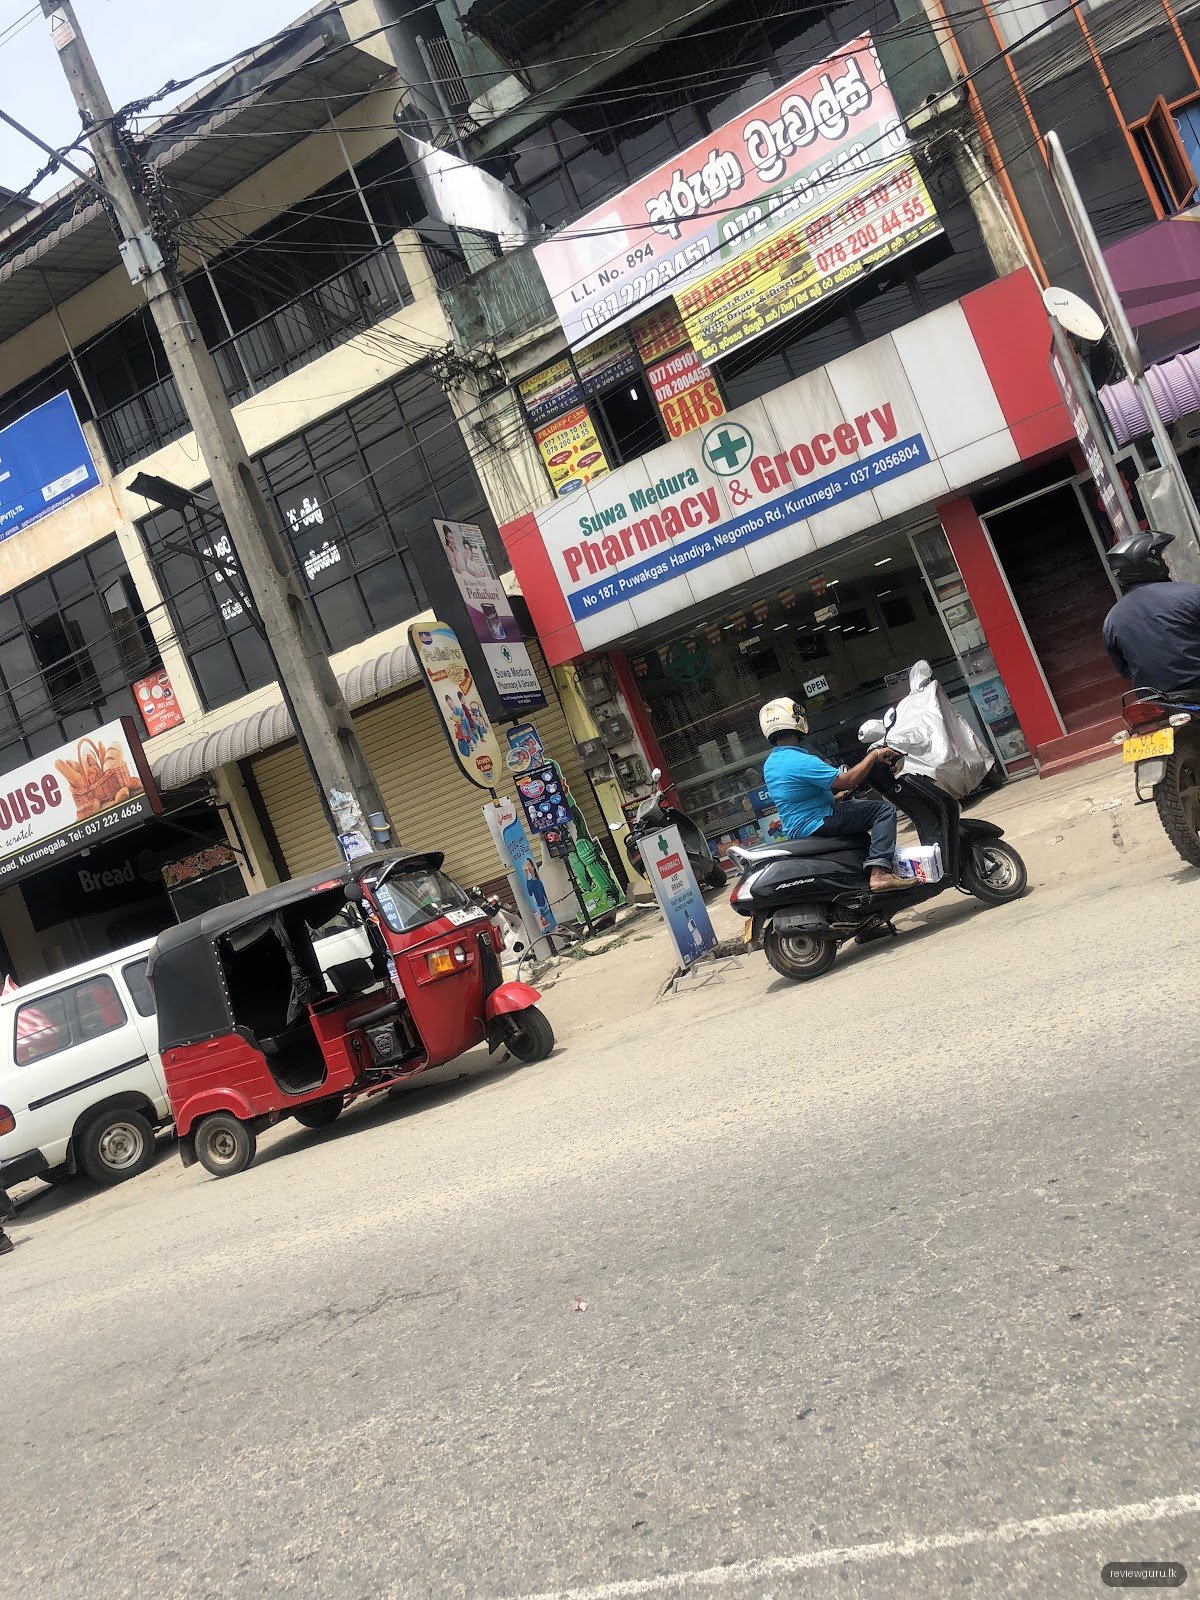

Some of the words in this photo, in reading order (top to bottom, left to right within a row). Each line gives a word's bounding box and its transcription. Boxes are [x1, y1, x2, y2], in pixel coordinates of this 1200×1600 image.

[816, 242, 847, 273] 078
[847, 223, 878, 255] 200
[881, 209, 902, 235] 44
[902, 196, 925, 223] 55
[571, 283, 596, 303] L.L.
[598, 267, 624, 287] No.
[626, 243, 654, 269] 894
[649, 366, 667, 385] 077
[666, 350, 699, 376] 119101
[655, 384, 673, 402] 078
[662, 380, 724, 439] CABS
[538, 420, 566, 440] PRADEEP
[562, 487, 721, 583] Pharmacy
[728, 479, 753, 506] &
[750, 402, 898, 494] Grocery
[579, 502, 628, 537] Suwa
[628, 467, 699, 512] Medura
[582, 594, 597, 608] No
[598, 584, 618, 600] 187,
[619, 561, 668, 591] Puwakgas
[670, 542, 715, 568] Handiya,
[714, 518, 764, 547] Negombo
[765, 507, 785, 525] Rd,
[785, 481, 842, 515] Kurunegla
[851, 466, 870, 485] 037
[872, 443, 920, 476] 2056804
[494, 668, 511, 679] Suwa
[510, 668, 532, 677] Medura
[806, 679, 827, 693] OPEN
[0, 860, 19, 876] oad,
[19, 840, 68, 866] Kurunegala.
[68, 829, 84, 843] Tel:
[85, 821, 101, 835] 037
[102, 812, 120, 828] 222
[121, 802, 143, 819] 4626
[78, 859, 135, 892] Bread
[658, 859, 681, 873] PHARMACY
[775, 876, 816, 891] Activa
